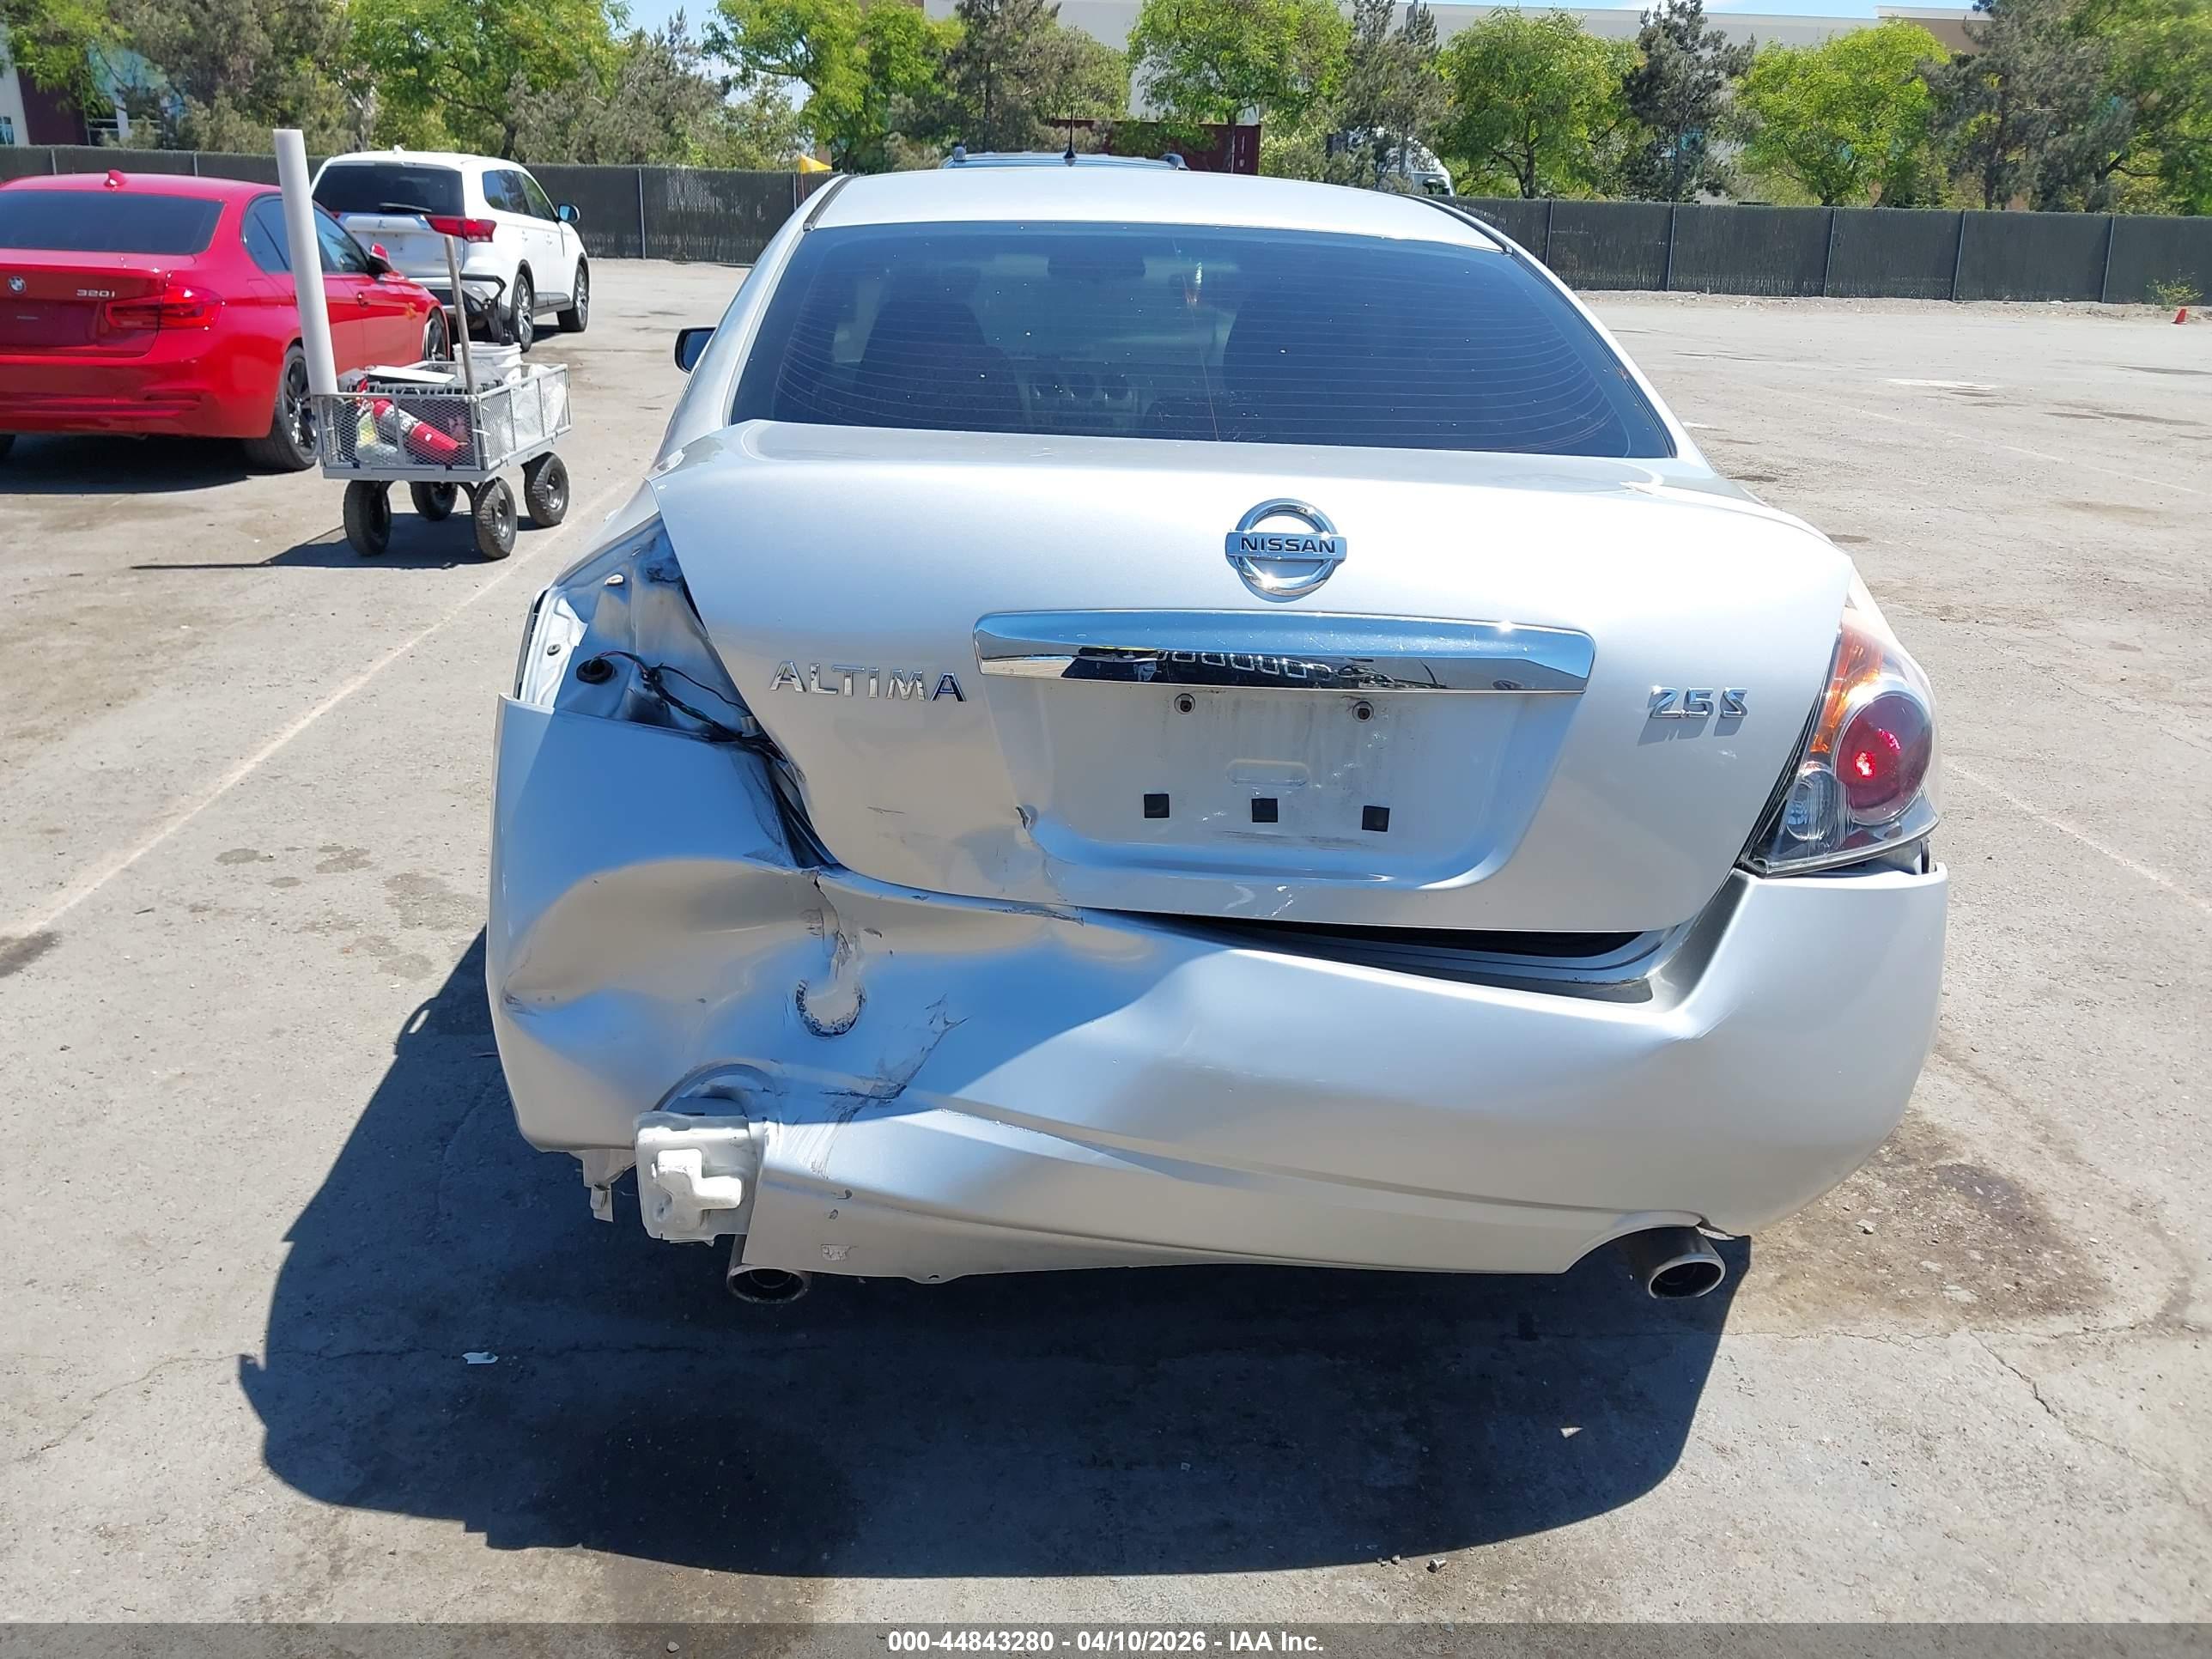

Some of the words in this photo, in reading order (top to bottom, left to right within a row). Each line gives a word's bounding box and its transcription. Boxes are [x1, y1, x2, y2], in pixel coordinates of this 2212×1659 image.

[1240, 537, 1336, 554] NISSAN
[769, 660, 967, 702] ALTIMA
[1720, 686, 1748, 719] S
